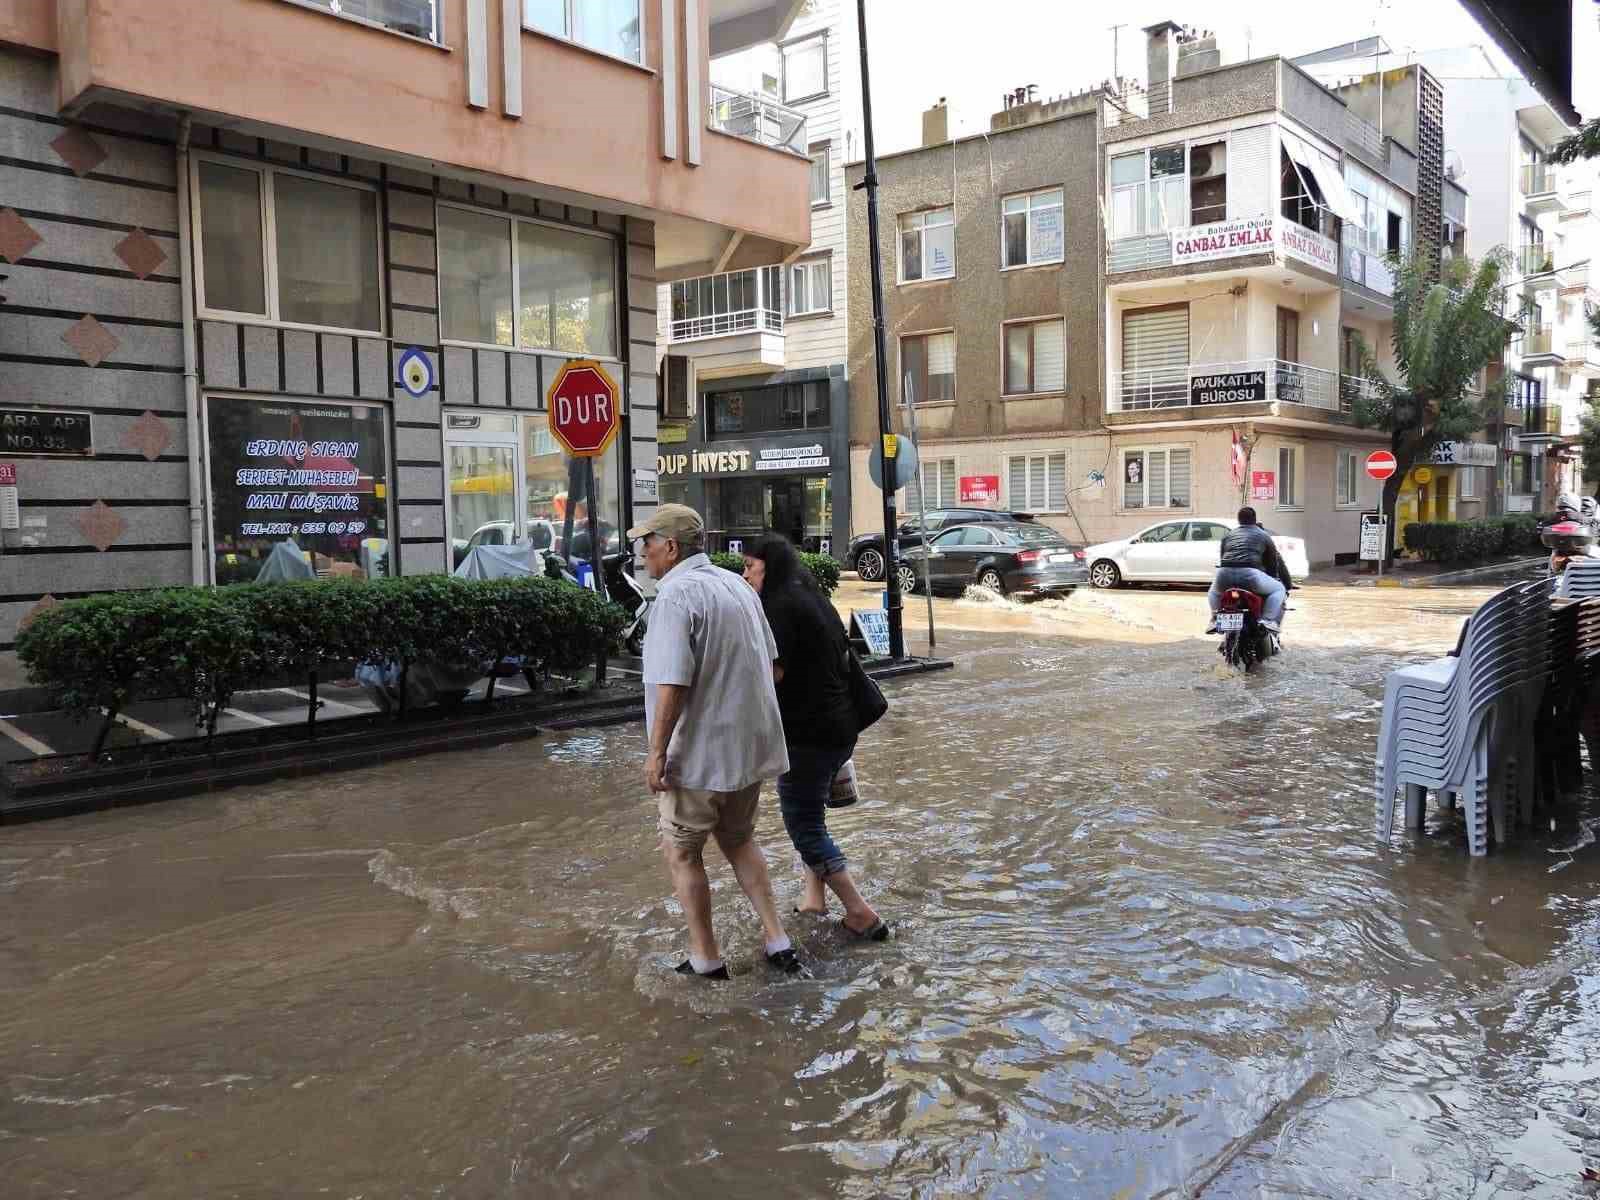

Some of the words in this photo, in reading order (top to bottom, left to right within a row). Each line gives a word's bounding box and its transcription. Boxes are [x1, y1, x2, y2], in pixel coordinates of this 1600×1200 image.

[1176, 234, 1226, 255] CANBAZ
[1229, 227, 1273, 248] EMLAK
[1192, 373, 1265, 390] AVUKATLIK
[558, 393, 609, 425] DUR
